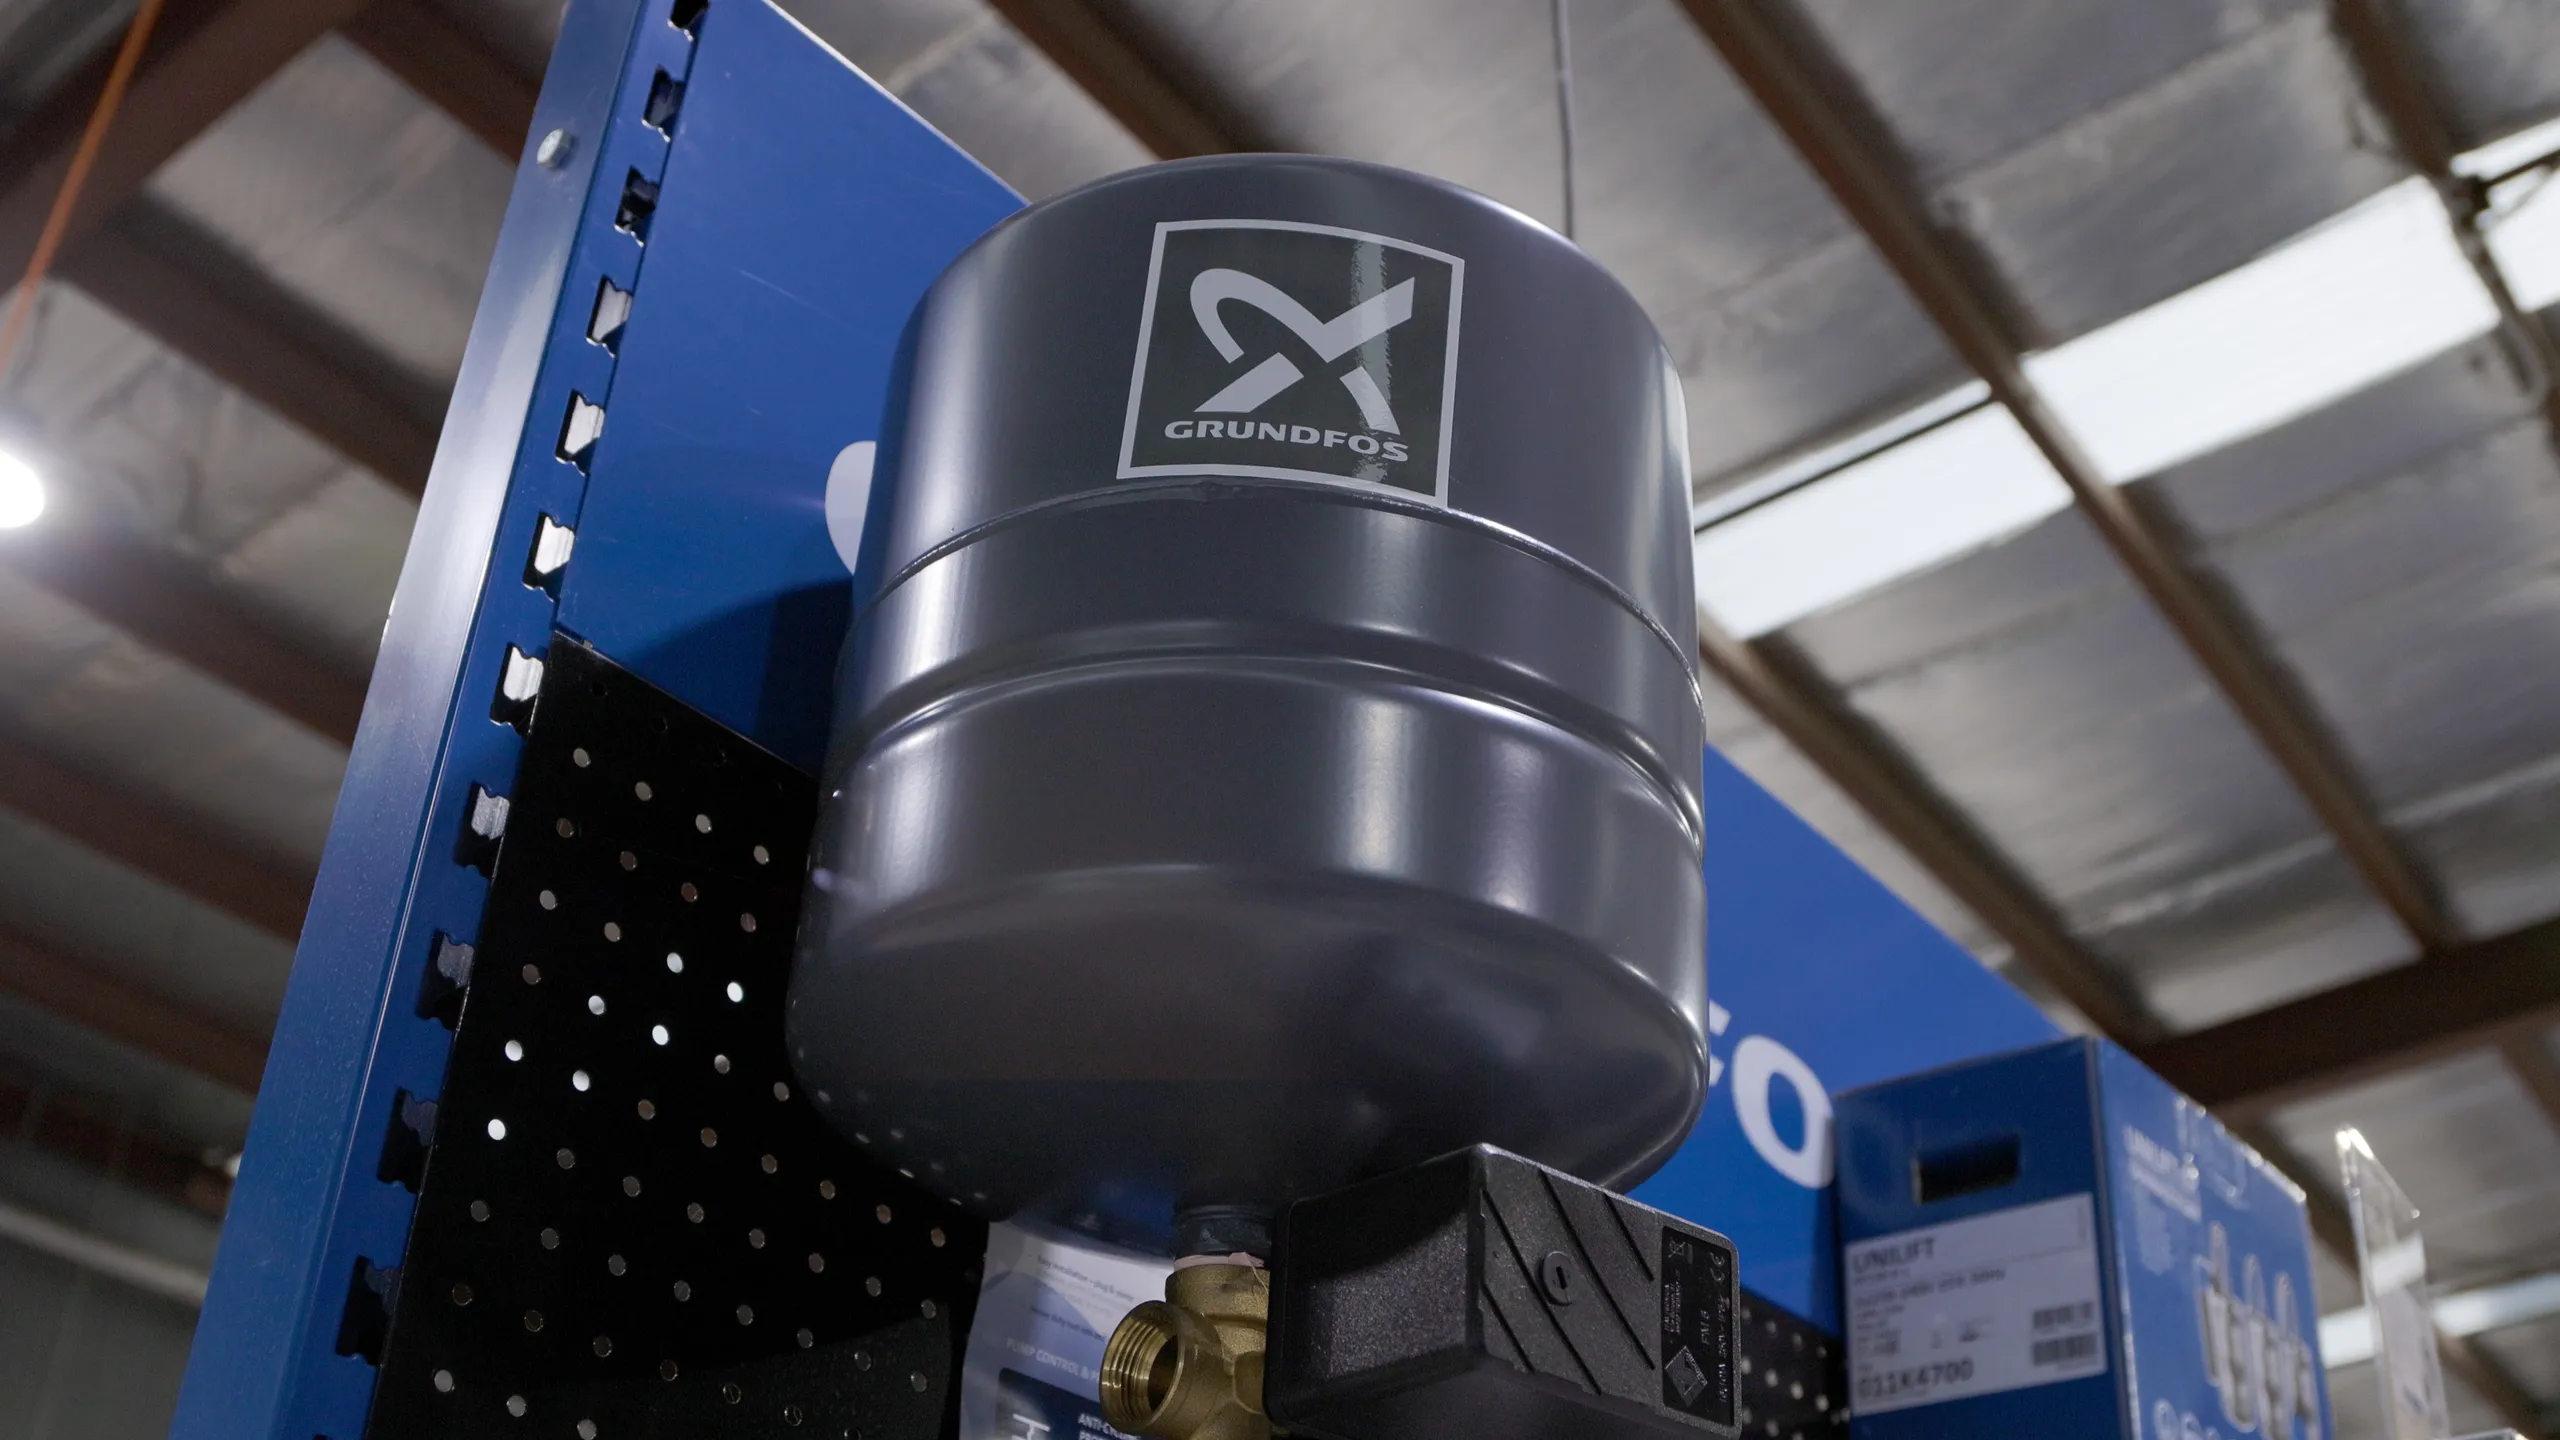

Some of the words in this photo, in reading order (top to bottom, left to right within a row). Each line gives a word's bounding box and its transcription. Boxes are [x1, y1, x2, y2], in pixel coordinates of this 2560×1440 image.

[1164, 420, 1409, 462] GRUNDFOS
[1851, 1236, 1935, 1274] UNILIFT
[1035, 1350, 1079, 1377] CONTROL
